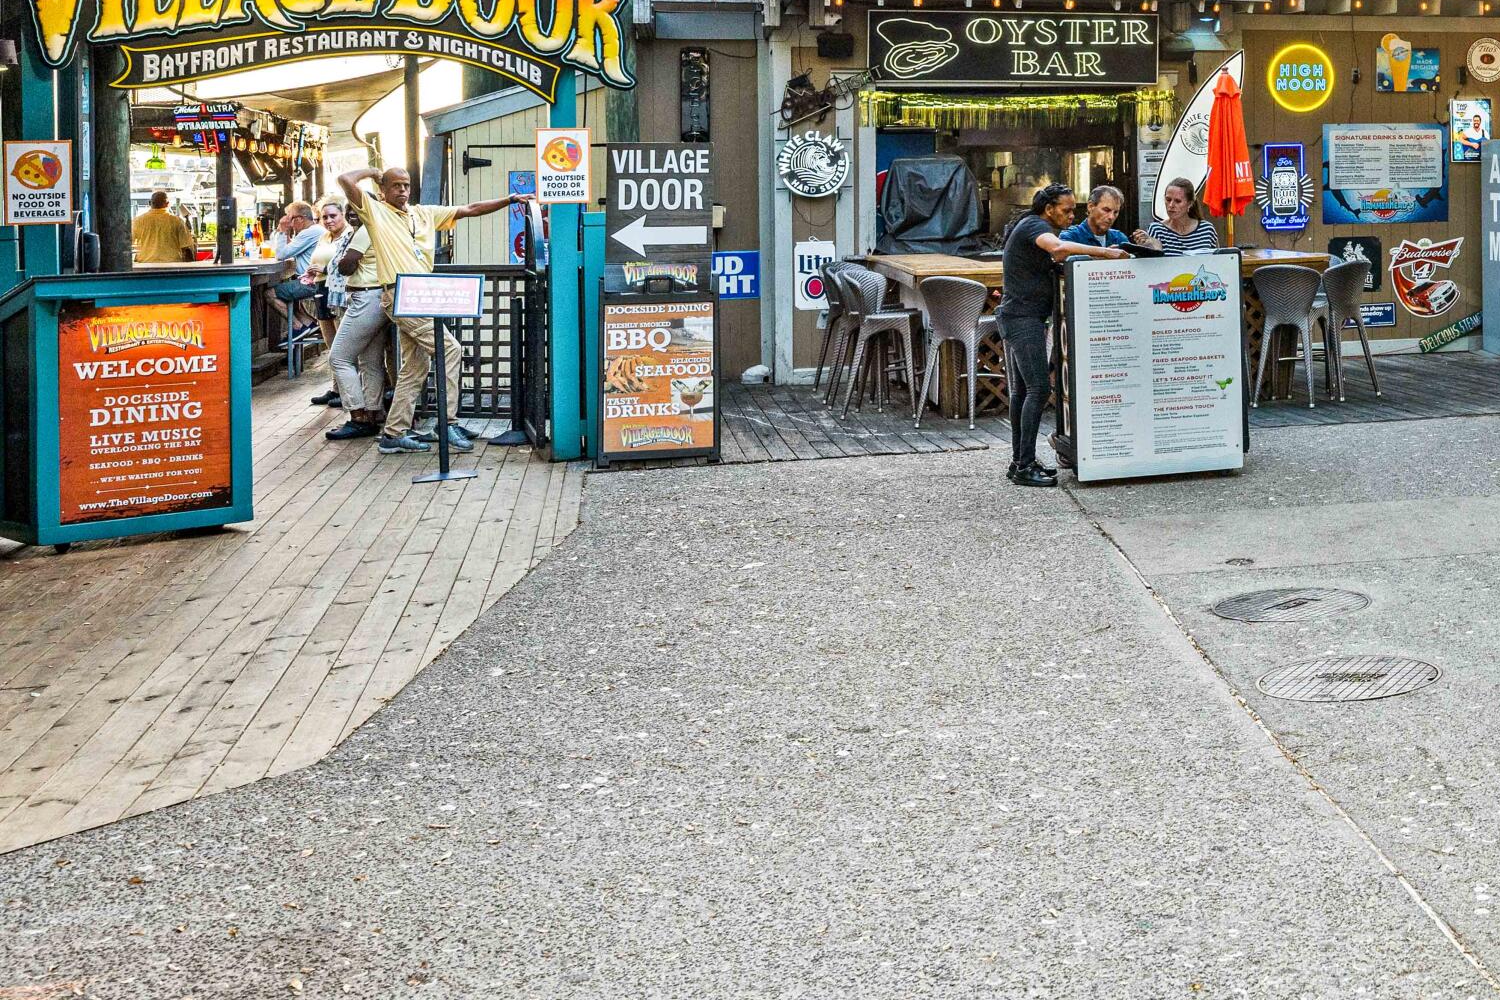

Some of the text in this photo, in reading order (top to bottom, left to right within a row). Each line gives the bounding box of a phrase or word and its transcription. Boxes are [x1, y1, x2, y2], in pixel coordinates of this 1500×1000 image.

[965, 17, 1154, 45] OYSTER
[142, 30, 542, 86] BAYFRONT RESTAURANT & NIGHTCLUB
[1010, 50, 1106, 77] BAR
[1279, 64, 1324, 77] HIGH
[1276, 78, 1327, 91] NOON
[206, 104, 235, 113] ULTRA
[1181, 113, 1202, 132] WHITE
[778, 130, 845, 175] WHITE CLAW
[612, 150, 709, 173] VILLAGE
[1277, 157, 1293, 167] For
[791, 159, 846, 193] HARD SELTZER
[28, 192, 66, 200] OUTSIDE
[618, 178, 703, 211] DOOR
[14, 210, 66, 218] BEVERAGES
[1261, 216, 1287, 227] Certified
[1390, 246, 1460, 260] Budweiser
[1415, 263, 1431, 278] 4
[1153, 288, 1226, 305] HAMMERHEAD'S
[608, 303, 710, 314] DOCKSIDE DINING
[86, 319, 206, 353] VILLAGE DOOR
[607, 328, 672, 353] BBQ
[1421, 326, 1460, 353] DELICIOUS
[73, 354, 217, 380] WELCOME
[635, 363, 711, 377] SEAFOOD
[104, 391, 190, 407] DOCKSIDE
[607, 397, 640, 405] TASTY
[90, 402, 203, 427] DINING
[607, 403, 680, 419] DRINKS
[90, 427, 202, 447] LIVE MUSIC
[91, 443, 161, 455] OVERLOOKING
[164, 441, 182, 449] THE
[89, 460, 133, 470] SEAFOOD
[169, 454, 203, 463] DRINKS
[128, 472, 164, 480] WAITING
[184, 468, 203, 476] YOU!
[79, 490, 213, 511] www.TheVillageDoor.com
